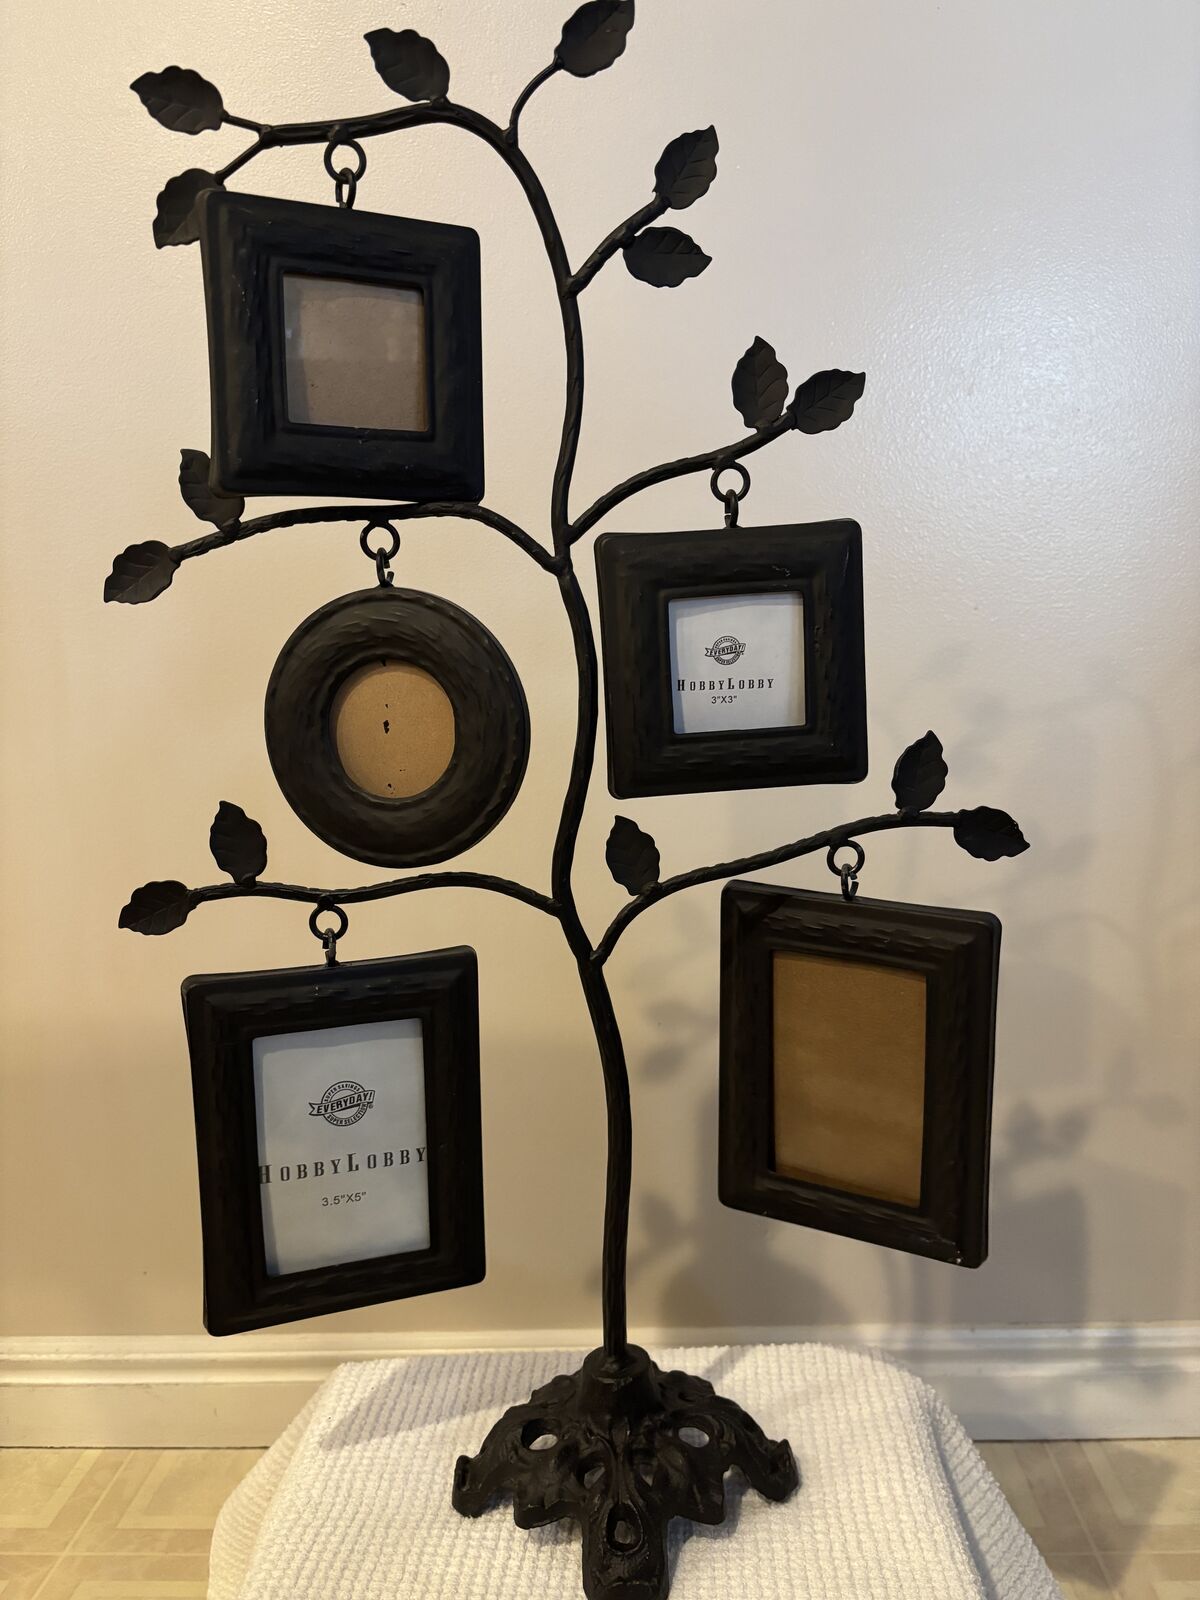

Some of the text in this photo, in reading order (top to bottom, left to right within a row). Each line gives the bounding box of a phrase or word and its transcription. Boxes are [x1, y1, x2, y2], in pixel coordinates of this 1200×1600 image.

[711, 695, 738, 705] 3"X3"
[317, 1091, 373, 1114] EVERYDAY!
[321, 1191, 367, 1207] 3.5"X5"
